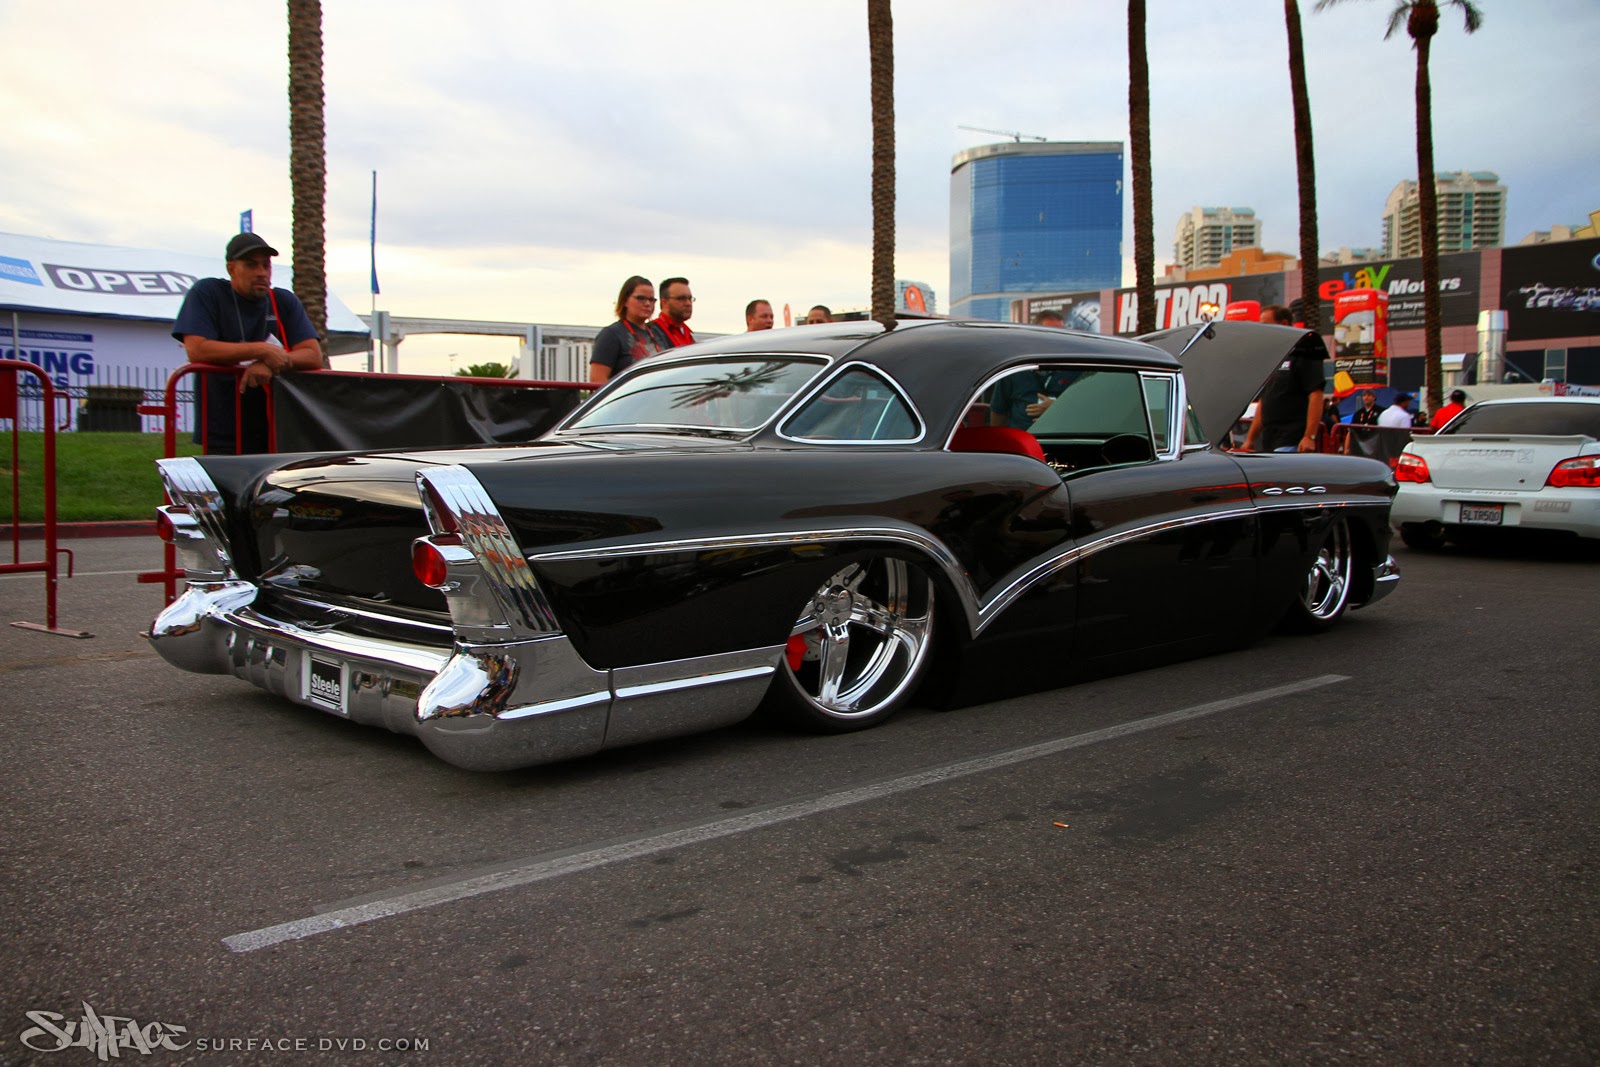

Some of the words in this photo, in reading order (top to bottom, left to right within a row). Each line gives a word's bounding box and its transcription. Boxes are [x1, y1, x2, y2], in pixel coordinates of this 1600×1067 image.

[55, 269, 195, 294] OPEN
[1388, 277, 1462, 296] Motrs
[1335, 360, 1354, 370] Clay
[1354, 358, 1374, 366] Bar
[311, 673, 340, 696] Steele
